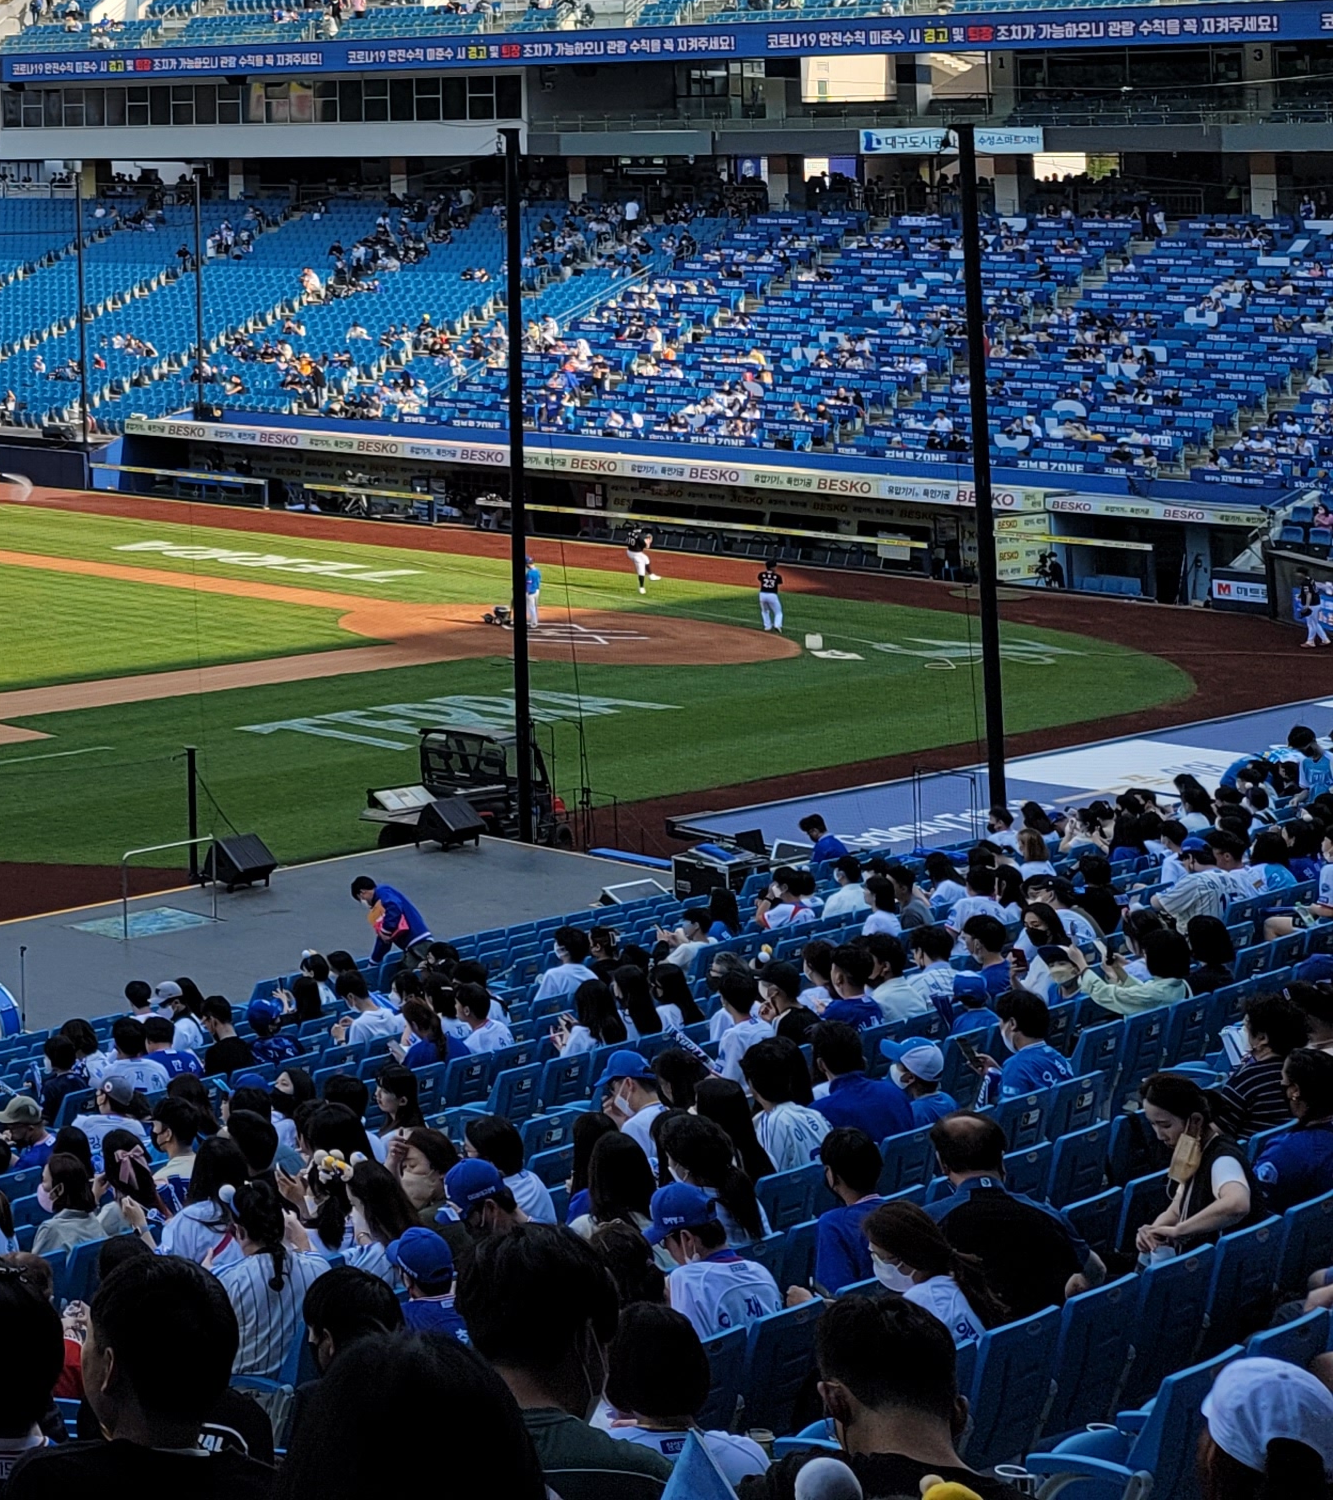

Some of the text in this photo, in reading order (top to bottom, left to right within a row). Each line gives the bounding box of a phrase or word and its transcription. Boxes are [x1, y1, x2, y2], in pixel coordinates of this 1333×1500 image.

[1253, 49, 1264, 62] 3
[998, 57, 1005, 69] 1
[168, 425, 206, 438] BESKO
[259, 433, 299, 447] BESKO
[357, 441, 398, 454] BESKO
[460, 449, 504, 463] BESKO
[571, 458, 617, 472] BESKO
[689, 467, 740, 483] BESKO
[817, 478, 872, 494] BESKO
[956, 490, 1015, 507] BEKO
[1052, 500, 1205, 521] BESKO BESKO
[997, 520, 1018, 529] BESKO
[998, 551, 1019, 561] BESKO
[763, 578, 776, 589] 23
[1217, 583, 1231, 596] M
